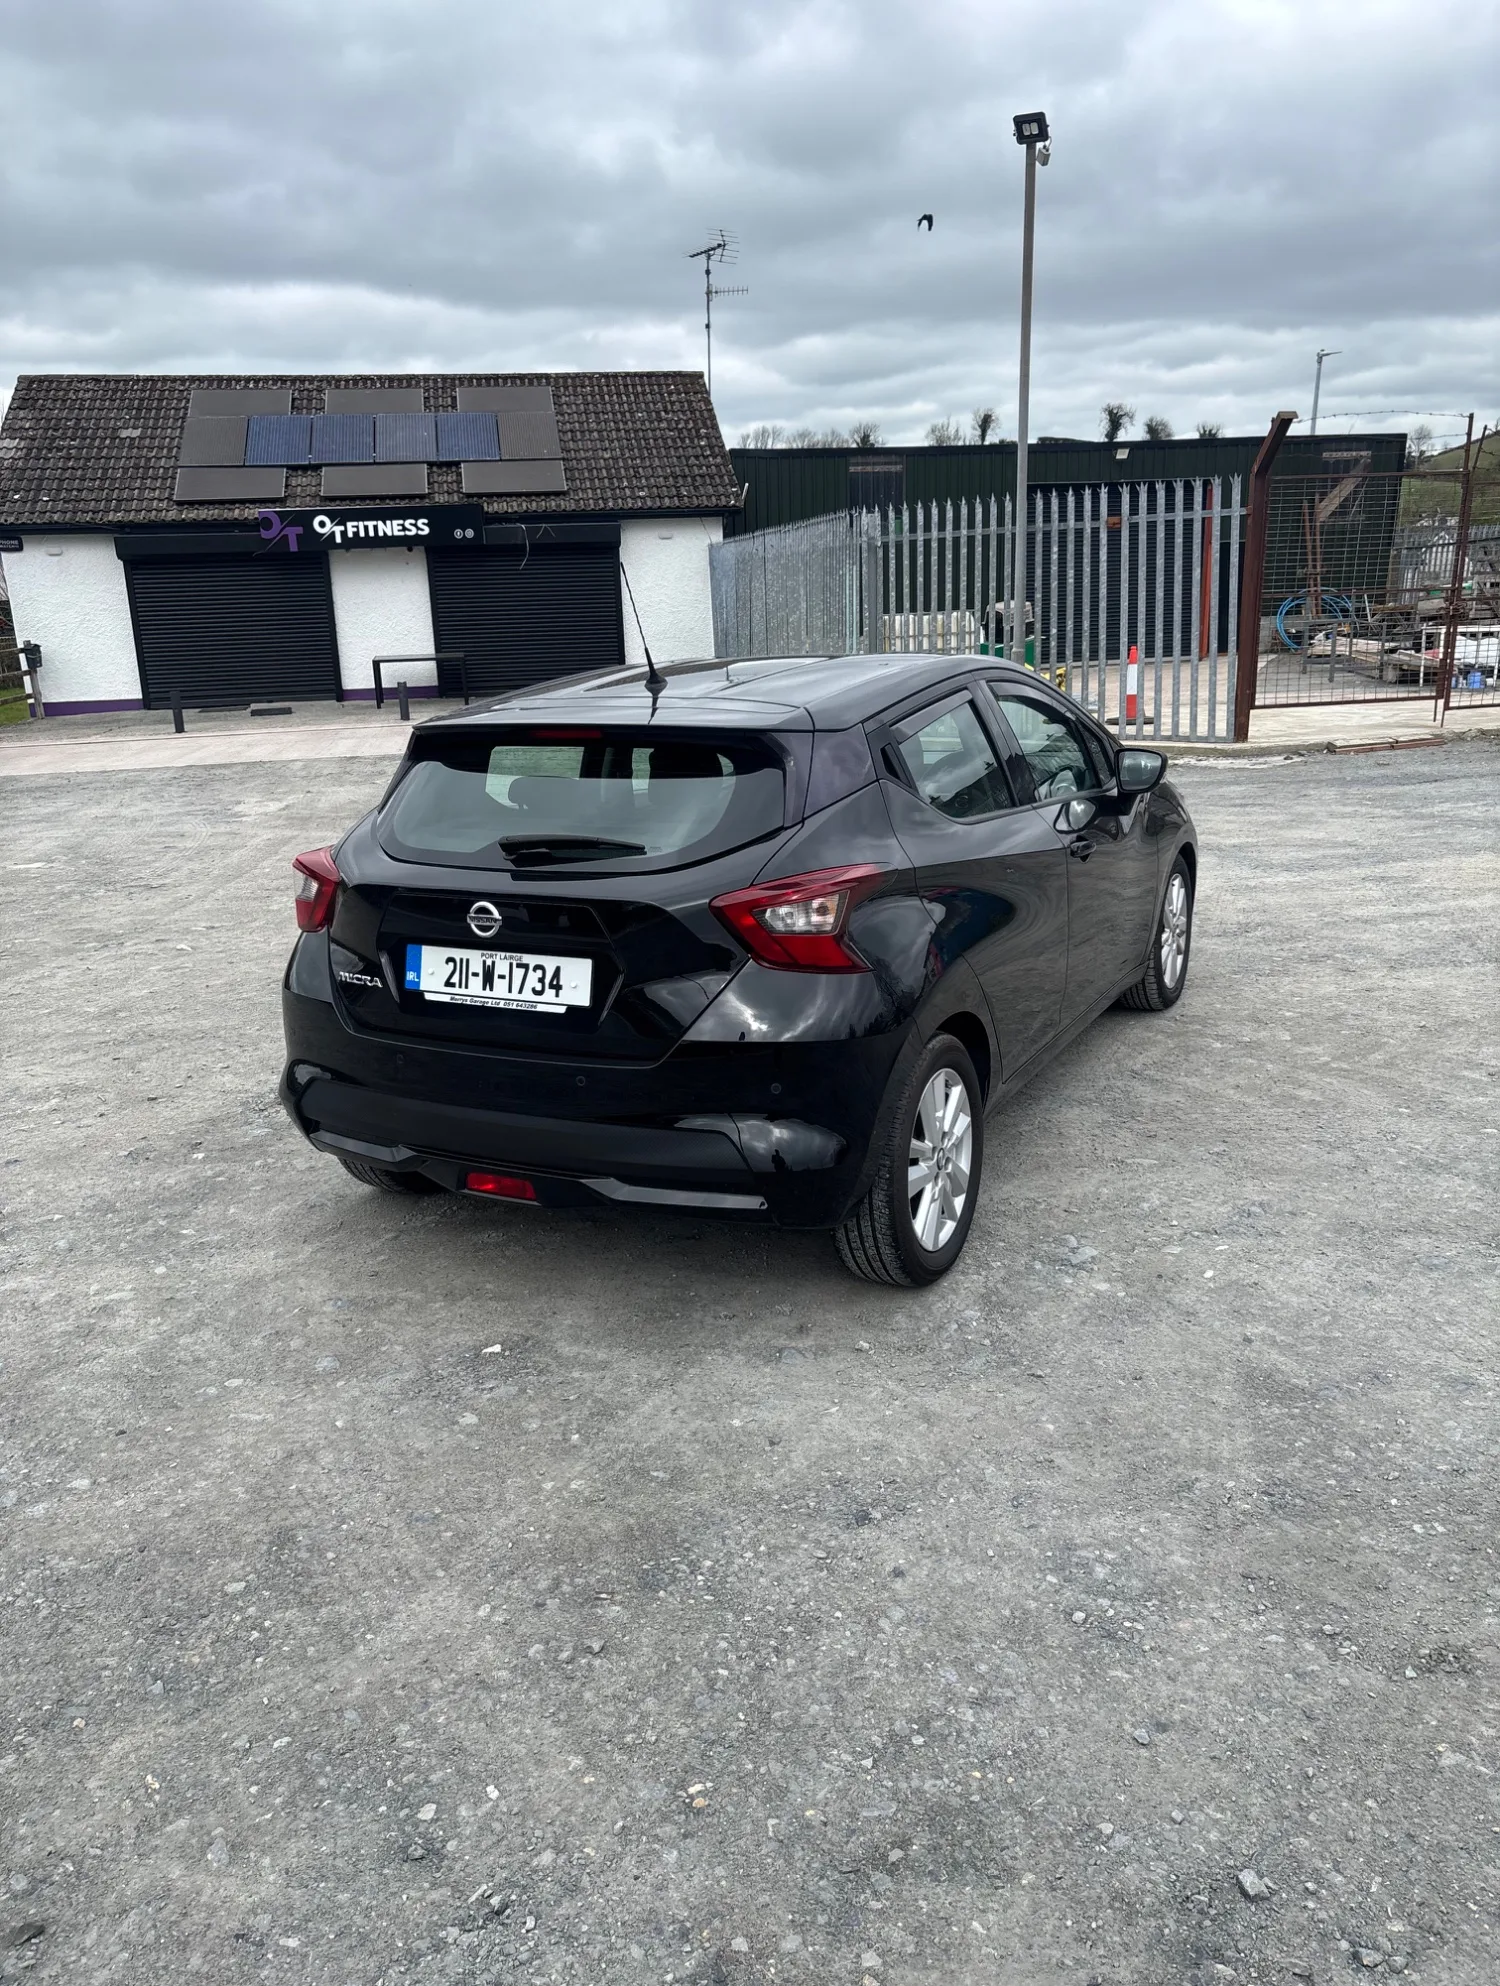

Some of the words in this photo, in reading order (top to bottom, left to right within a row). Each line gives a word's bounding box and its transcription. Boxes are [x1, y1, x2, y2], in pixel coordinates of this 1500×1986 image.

[346, 518, 430, 538] FITNESS
[480, 952, 498, 960] PORT
[338, 971, 383, 988] MICRA
[406, 971, 420, 982] IRL
[443, 956, 563, 998] 211-W-1734
[469, 998, 489, 1006] Garage
[515, 1002, 538, 1010] 643286
